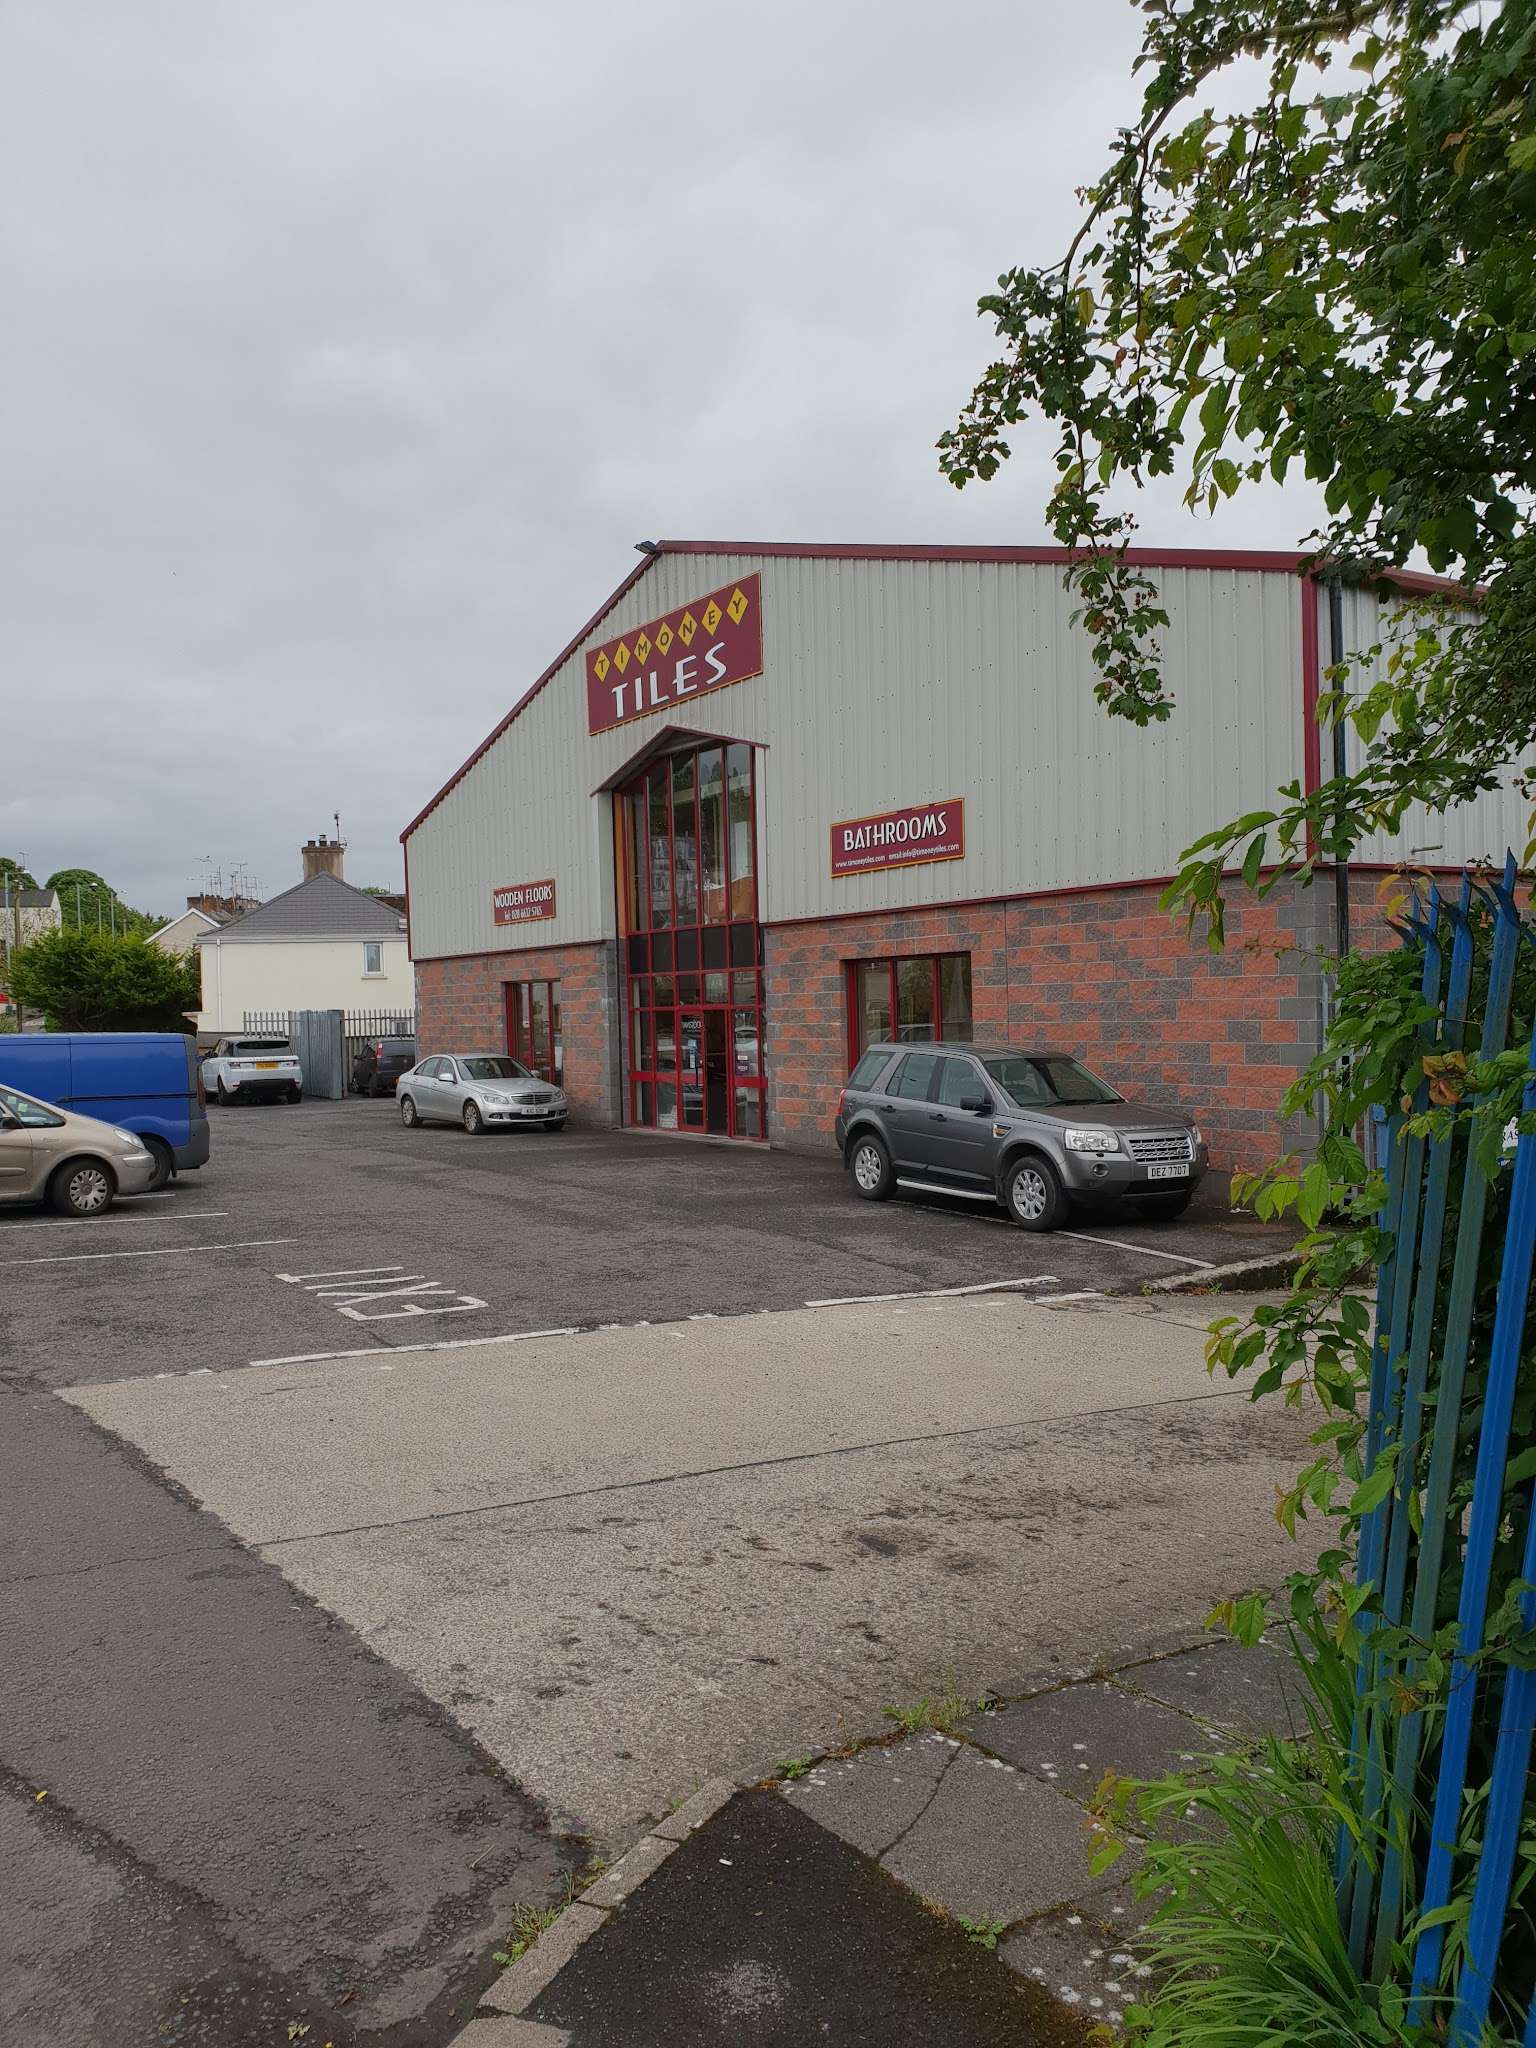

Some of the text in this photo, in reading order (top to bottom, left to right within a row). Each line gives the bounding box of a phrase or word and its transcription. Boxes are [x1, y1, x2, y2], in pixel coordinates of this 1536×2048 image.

[598, 597, 743, 672] TIMONEY
[611, 641, 727, 719] TILES
[844, 811, 947, 852] BATHROOMS
[494, 885, 553, 908] WOODEN FLOORS
[1151, 1167, 1166, 1177] DEZ
[274, 1266, 489, 1321] EXIT
